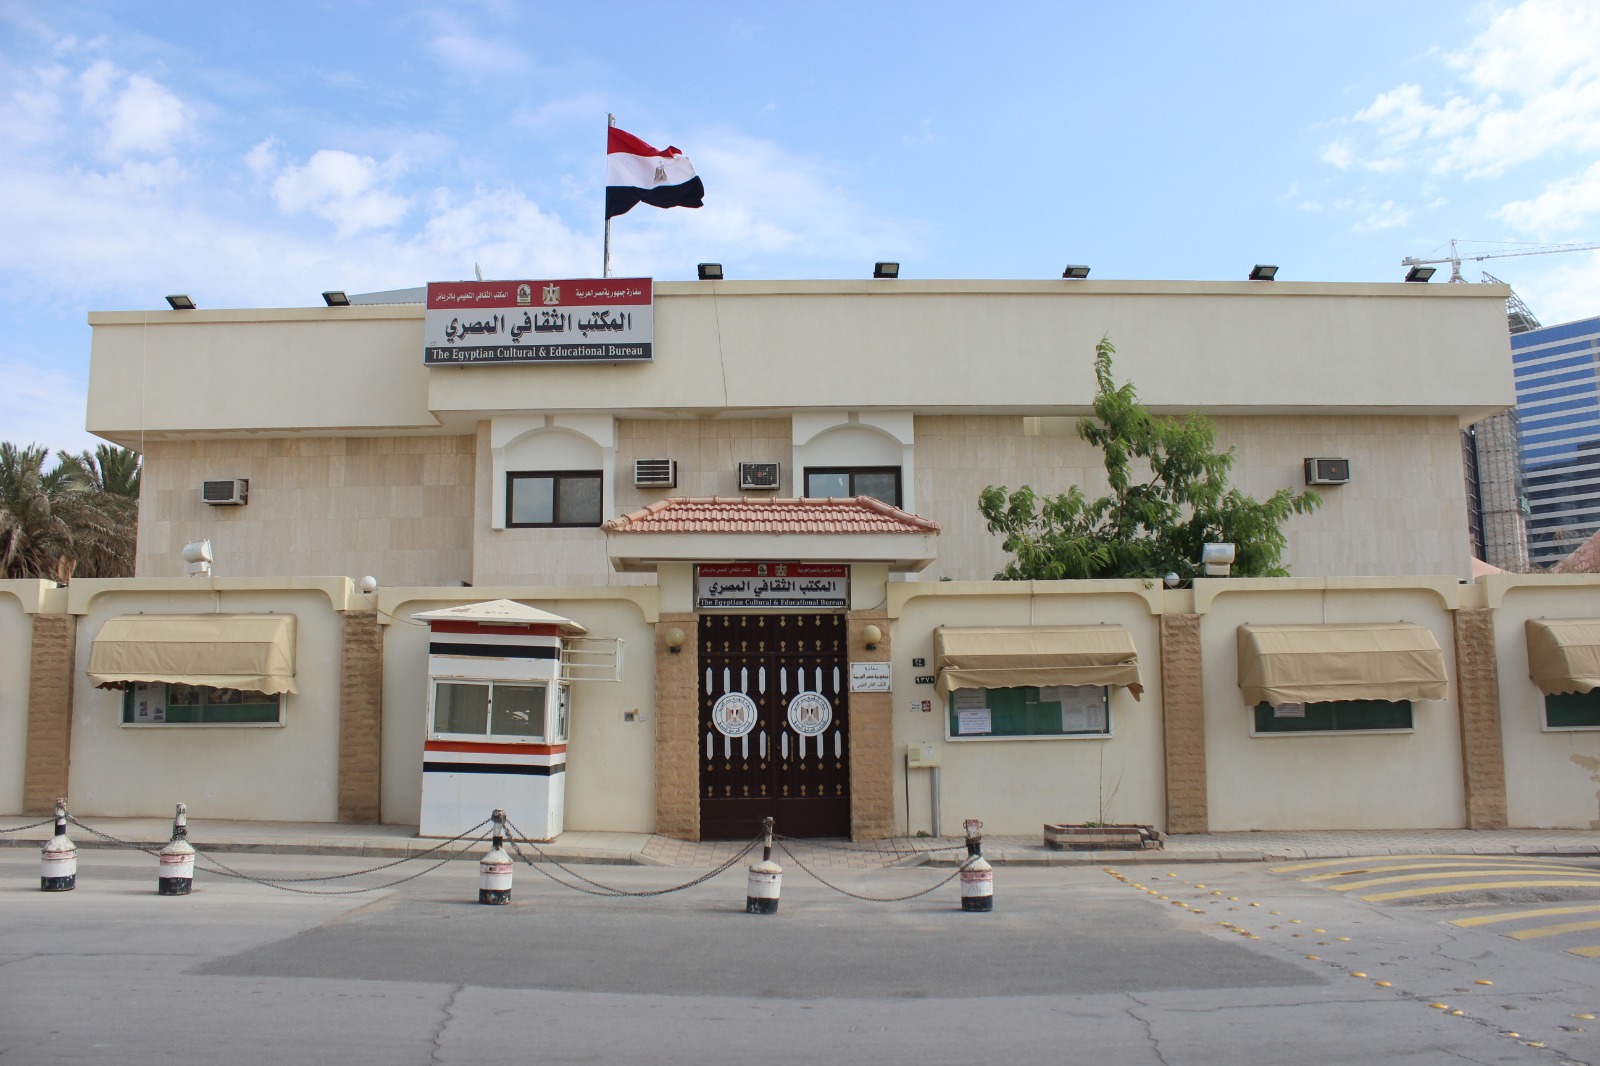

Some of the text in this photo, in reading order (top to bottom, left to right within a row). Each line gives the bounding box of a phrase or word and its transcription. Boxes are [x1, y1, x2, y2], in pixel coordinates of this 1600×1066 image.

[475, 290, 493, 301] الثقافي
[493, 291, 509, 300] المكتب
[575, 288, 594, 299] العربية
[626, 287, 642, 296] سفارة
[445, 308, 632, 344] المكتب الثقافي المصري
[432, 345, 643, 361] The Egyptian Cultural & Educational Bureau
[708, 578, 837, 598] المكتب الثقافي المصري
[714, 599, 744, 607] Egyptian
